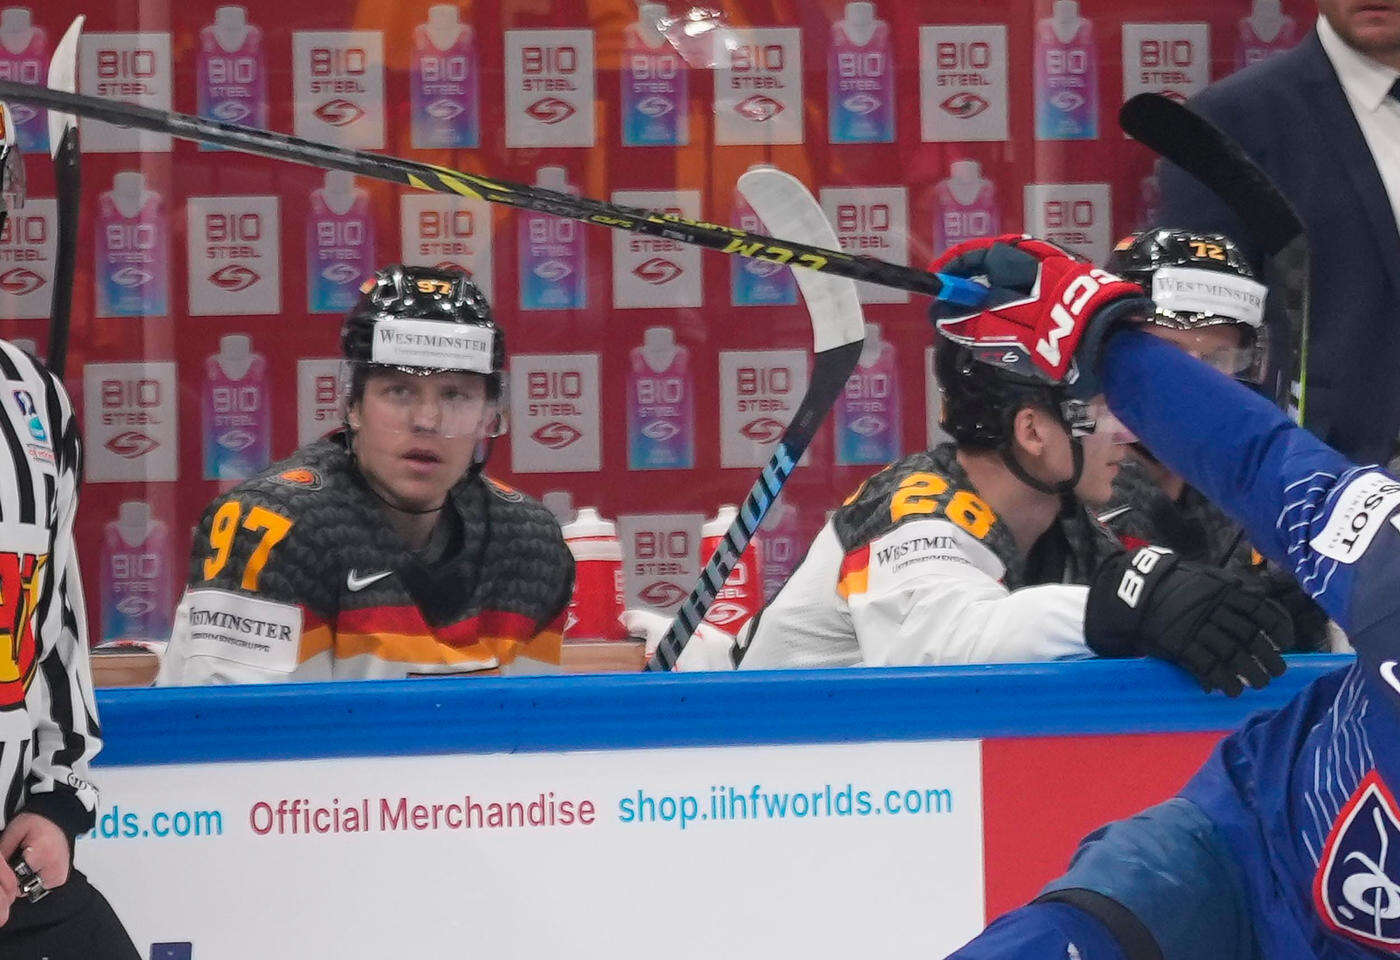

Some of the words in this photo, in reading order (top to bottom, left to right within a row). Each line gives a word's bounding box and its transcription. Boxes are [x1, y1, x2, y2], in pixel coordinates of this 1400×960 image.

[98, 50, 155, 78] BIO
[310, 48, 366, 76] BIO
[522, 47, 578, 75] BIO
[731, 44, 784, 71] BIO
[838, 53, 882, 77] BIO
[937, 42, 991, 69] BIO
[1140, 41, 1194, 67] BIO
[208, 59, 254, 83] BIO
[421, 57, 466, 81] BIO
[631, 56, 676, 80] BIO
[937, 74, 991, 86] STEEL
[1141, 72, 1192, 84] STEEL
[97, 83, 155, 95] STEEL
[310, 81, 365, 94] STEEL
[522, 79, 578, 92] STEEL
[731, 76, 784, 89] STEEL
[420, 211, 474, 238] BIO
[838, 204, 890, 232] BIO
[1045, 201, 1094, 227] BIO
[107, 225, 154, 249] BIO
[206, 214, 260, 242] BIO
[317, 222, 362, 246] BIO
[0, 251, 47, 261] TEEL
[207, 247, 262, 258] STEEL
[420, 243, 473, 255] STEEL
[631, 239, 683, 251] STEEL
[721, 238, 828, 271] CCM
[1189, 240, 1226, 260] 72
[418, 279, 452, 295] 97
[1157, 277, 1263, 305] WESTMINSTER
[380, 329, 487, 351] WESTMINSTER
[102, 380, 160, 408] BIO
[528, 372, 582, 399] BIO
[637, 379, 682, 404] BIO
[736, 368, 792, 396] BIO
[213, 386, 258, 411] BIO
[528, 404, 582, 417] STEEL
[737, 400, 792, 412] STEEL
[103, 413, 161, 425] STEEL
[890, 472, 999, 540] 28
[203, 500, 294, 591] 97
[635, 532, 688, 558] BIO
[112, 555, 156, 578] BIO
[635, 563, 690, 575] STEEL
[250, 798, 369, 836] Official
[379, 792, 596, 831] Merchandise
[617, 783, 954, 831] shop.iihfworlds.com
[91, 805, 222, 838] ds.com
